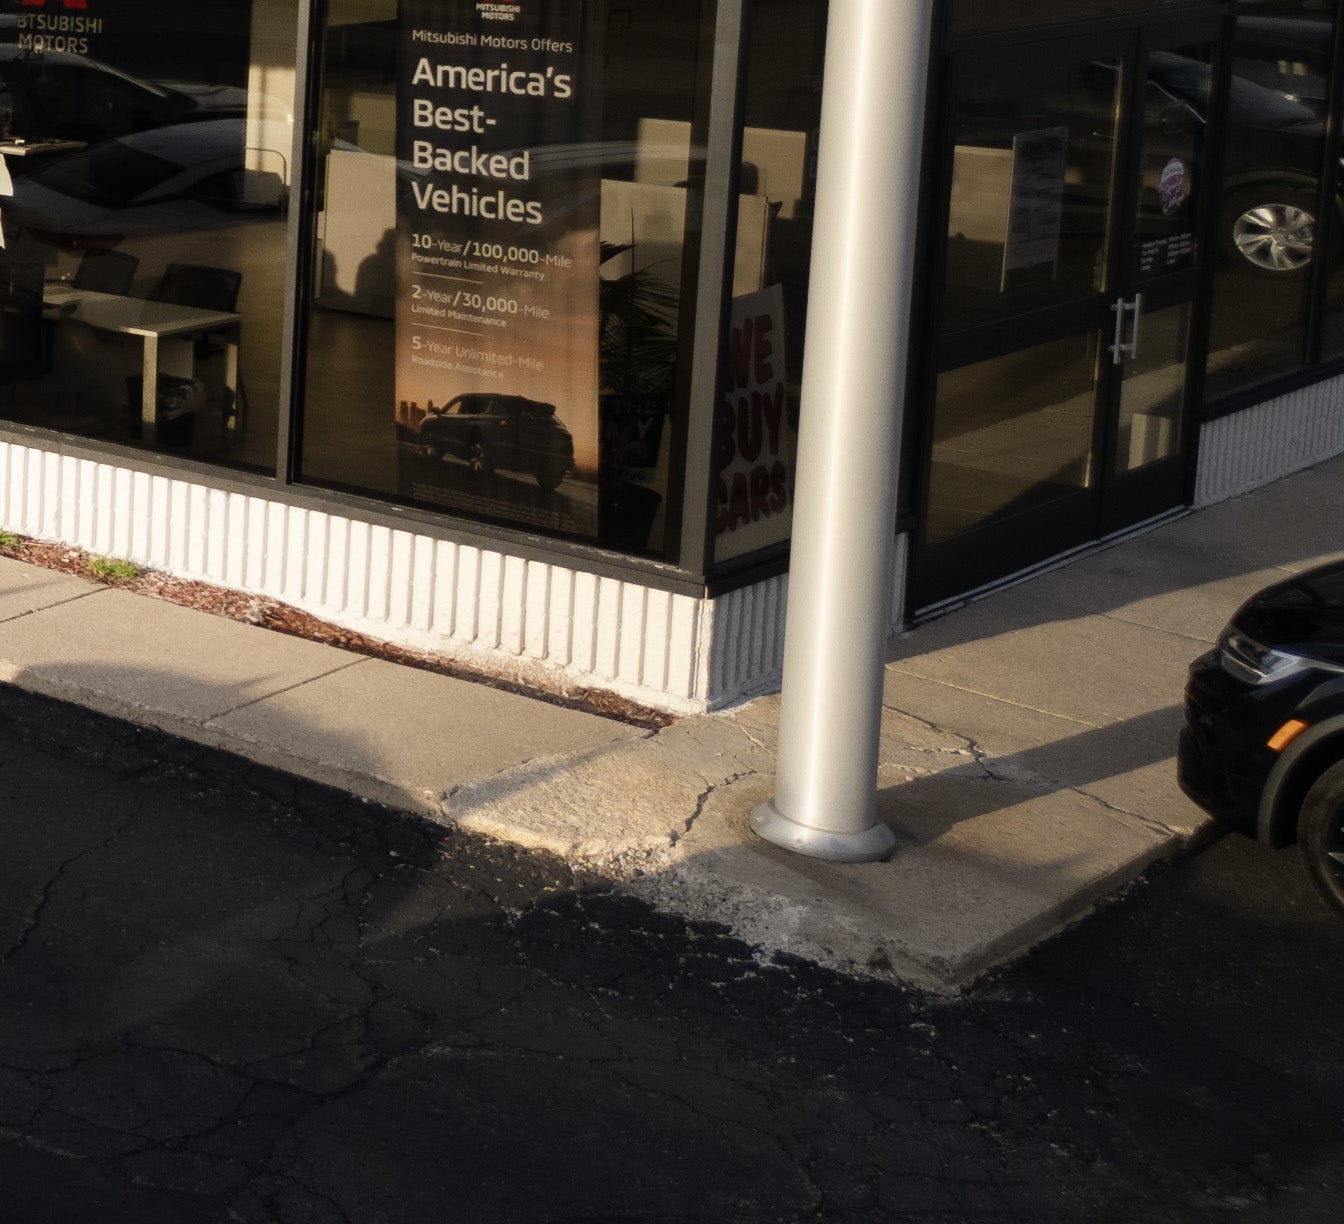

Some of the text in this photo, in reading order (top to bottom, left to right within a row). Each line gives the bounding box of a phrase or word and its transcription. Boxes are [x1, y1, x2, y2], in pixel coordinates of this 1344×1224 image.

[476, 3, 521, 13] MITSUBISHI
[481, 12, 515, 21] MOTORS
[18, 33, 89, 54] MOTORS
[412, 29, 573, 53] Mitsubishi Motors Offers
[412, 57, 572, 98] America's
[413, 99, 497, 134] Best-
[413, 140, 530, 181] Backed
[411, 181, 543, 225] Vehicles
[411, 252, 545, 282] Powertrain Limited Warranty
[411, 304, 508, 328] Limited Maintenance
[412, 336, 452, 356] 5-Year
[454, 362, 505, 379] Assistance
[719, 381, 785, 470] BUY
